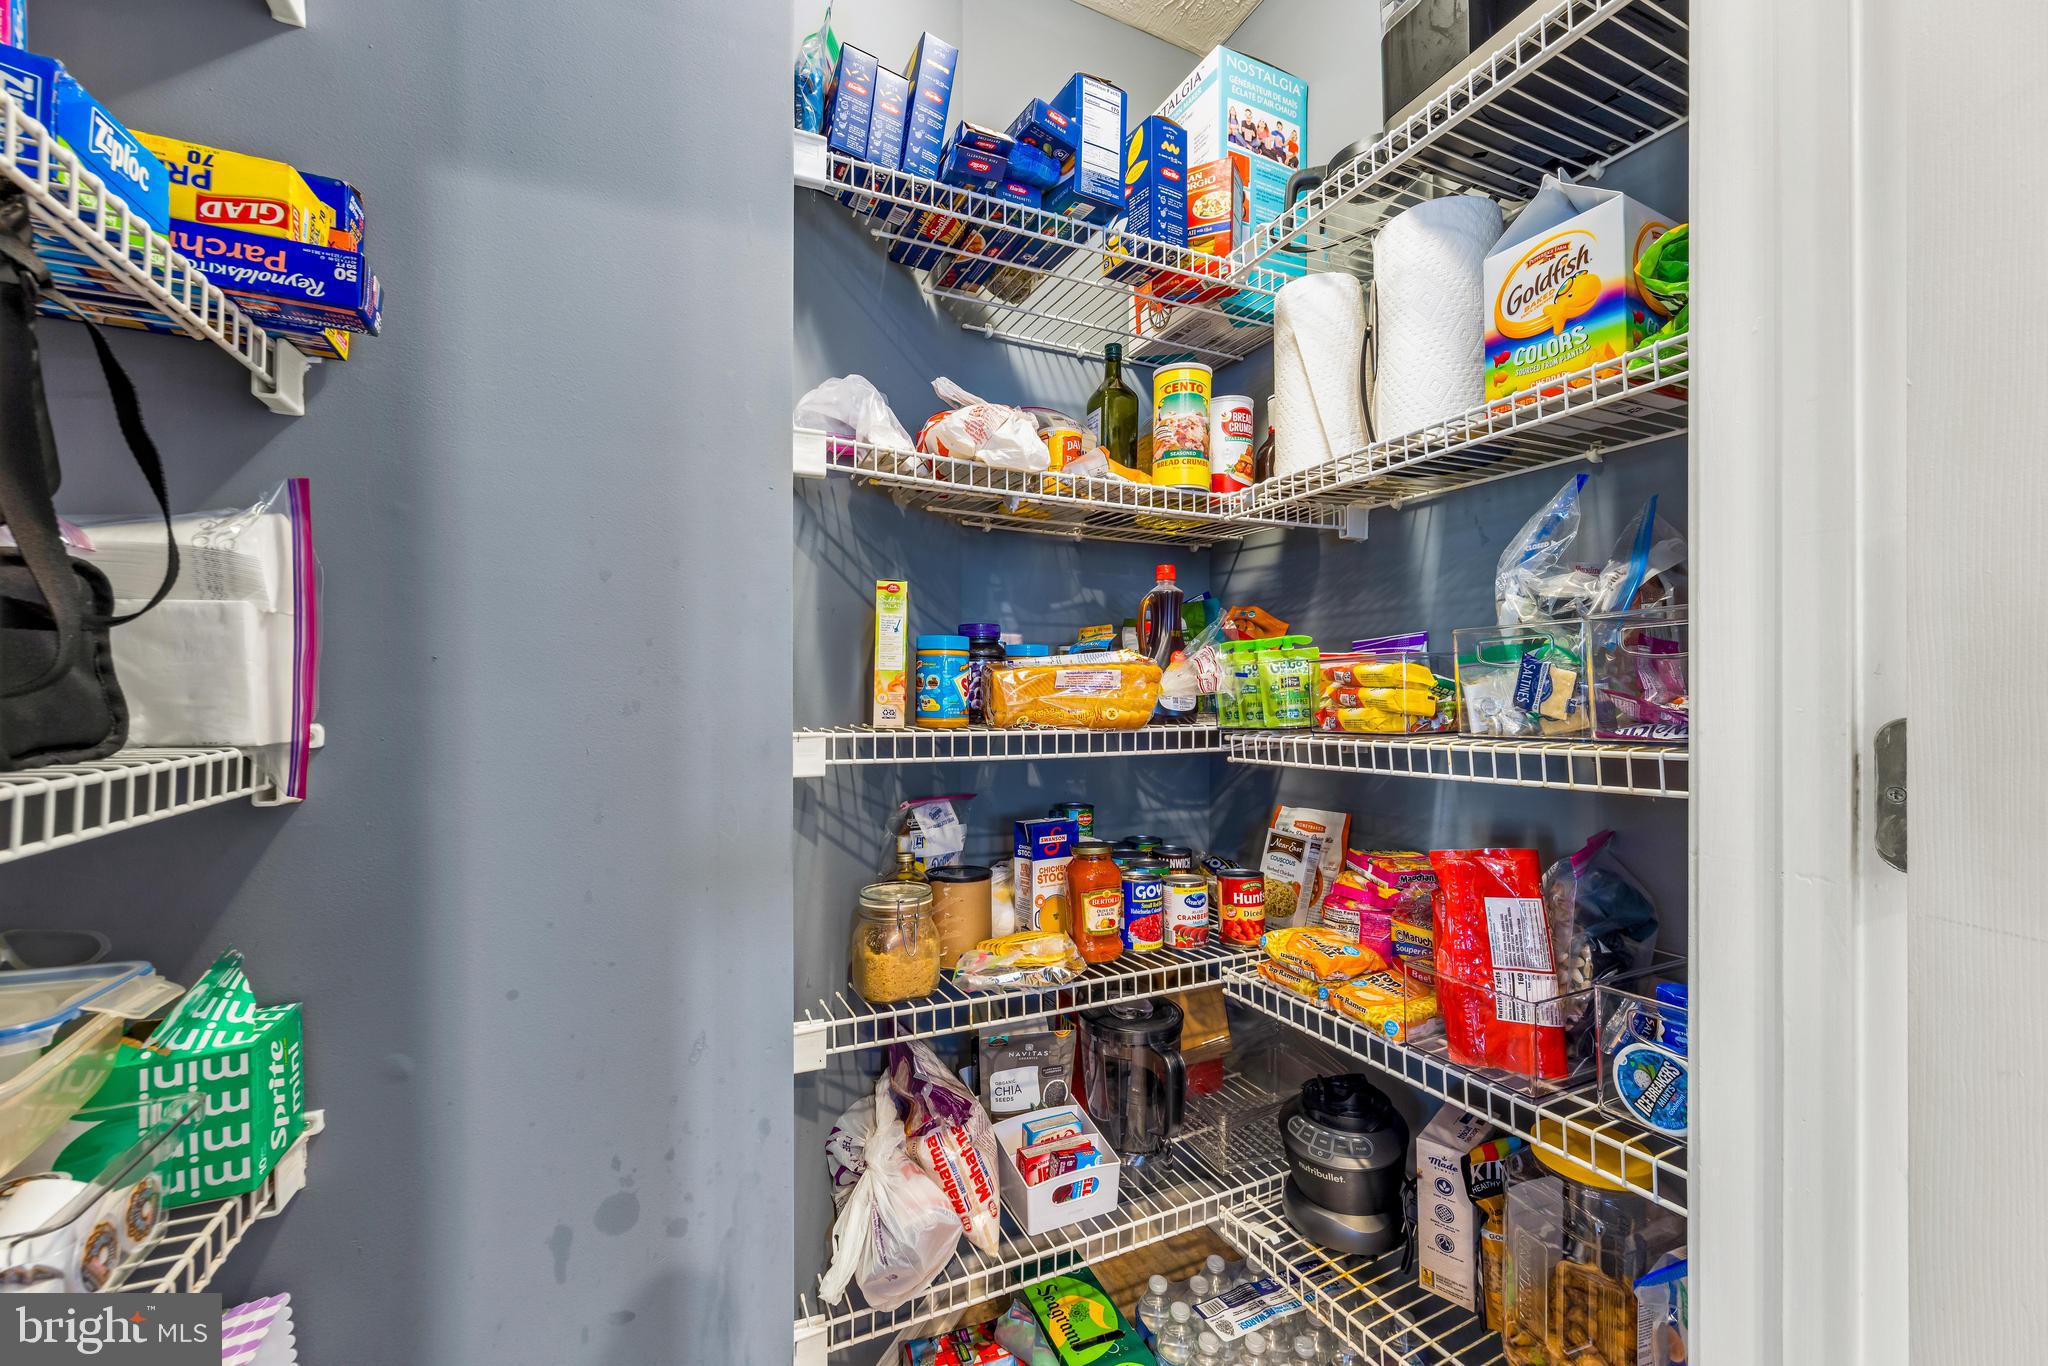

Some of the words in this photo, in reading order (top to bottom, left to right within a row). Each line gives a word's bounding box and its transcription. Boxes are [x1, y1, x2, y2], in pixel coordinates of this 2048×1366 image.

[1227, 54, 1302, 96] NOSTALGIA
[1275, 103, 1297, 118] CHAUD
[94, 115, 150, 192] Ziploc
[187, 150, 215, 168] 70
[160, 162, 213, 192] PR
[1187, 175, 1216, 191] RGIO
[200, 200, 285, 225] GLAD
[226, 265, 326, 297] Reynolds
[334, 267, 358, 283] 50
[1507, 243, 1589, 316] Goldfish
[1523, 288, 1556, 313] BAKED
[1514, 325, 1588, 367] COLORS
[1515, 363, 1541, 377] SOURCED
[1542, 357, 1559, 370] FROM
[1560, 347, 1584, 363] PLANTS
[1164, 381, 1204, 395] CENTO
[1156, 458, 1180, 468] BREAD
[1181, 457, 1208, 468] CRUMBS
[1517, 660, 1535, 705] SALTINES
[1039, 834, 1068, 844] SWANSON
[1270, 838, 1289, 850] Near
[1288, 841, 1303, 853] East
[1270, 854, 1296, 867] COUSCOUS
[1279, 869, 1295, 878] Chicken
[1135, 885, 1162, 900] GOY
[1243, 909, 1264, 918] Diced
[1395, 943, 1421, 956] Souper
[1278, 968, 1302, 984] Ramen
[1376, 971, 1402, 989] Top
[1344, 997, 1367, 1014] Ramen
[1008, 1050, 1049, 1058] NAVITAS
[138, 1052, 250, 1101] mini
[288, 1040, 302, 1114] mini
[994, 1078, 1016, 1087] ORGANIC
[268, 1039, 290, 1150] Sprite
[994, 1084, 1023, 1098] CHIA
[994, 1095, 1015, 1103] SEEDS
[1656, 1084, 1677, 1108] MINTS
[258, 1157, 267, 1175] 10
[1429, 1157, 1459, 1173] Made
[927, 1135, 967, 1216] Mahatma
[1472, 1180, 1502, 1194] HEALTHY
[1237, 1307, 1276, 1331] REWARDS!
